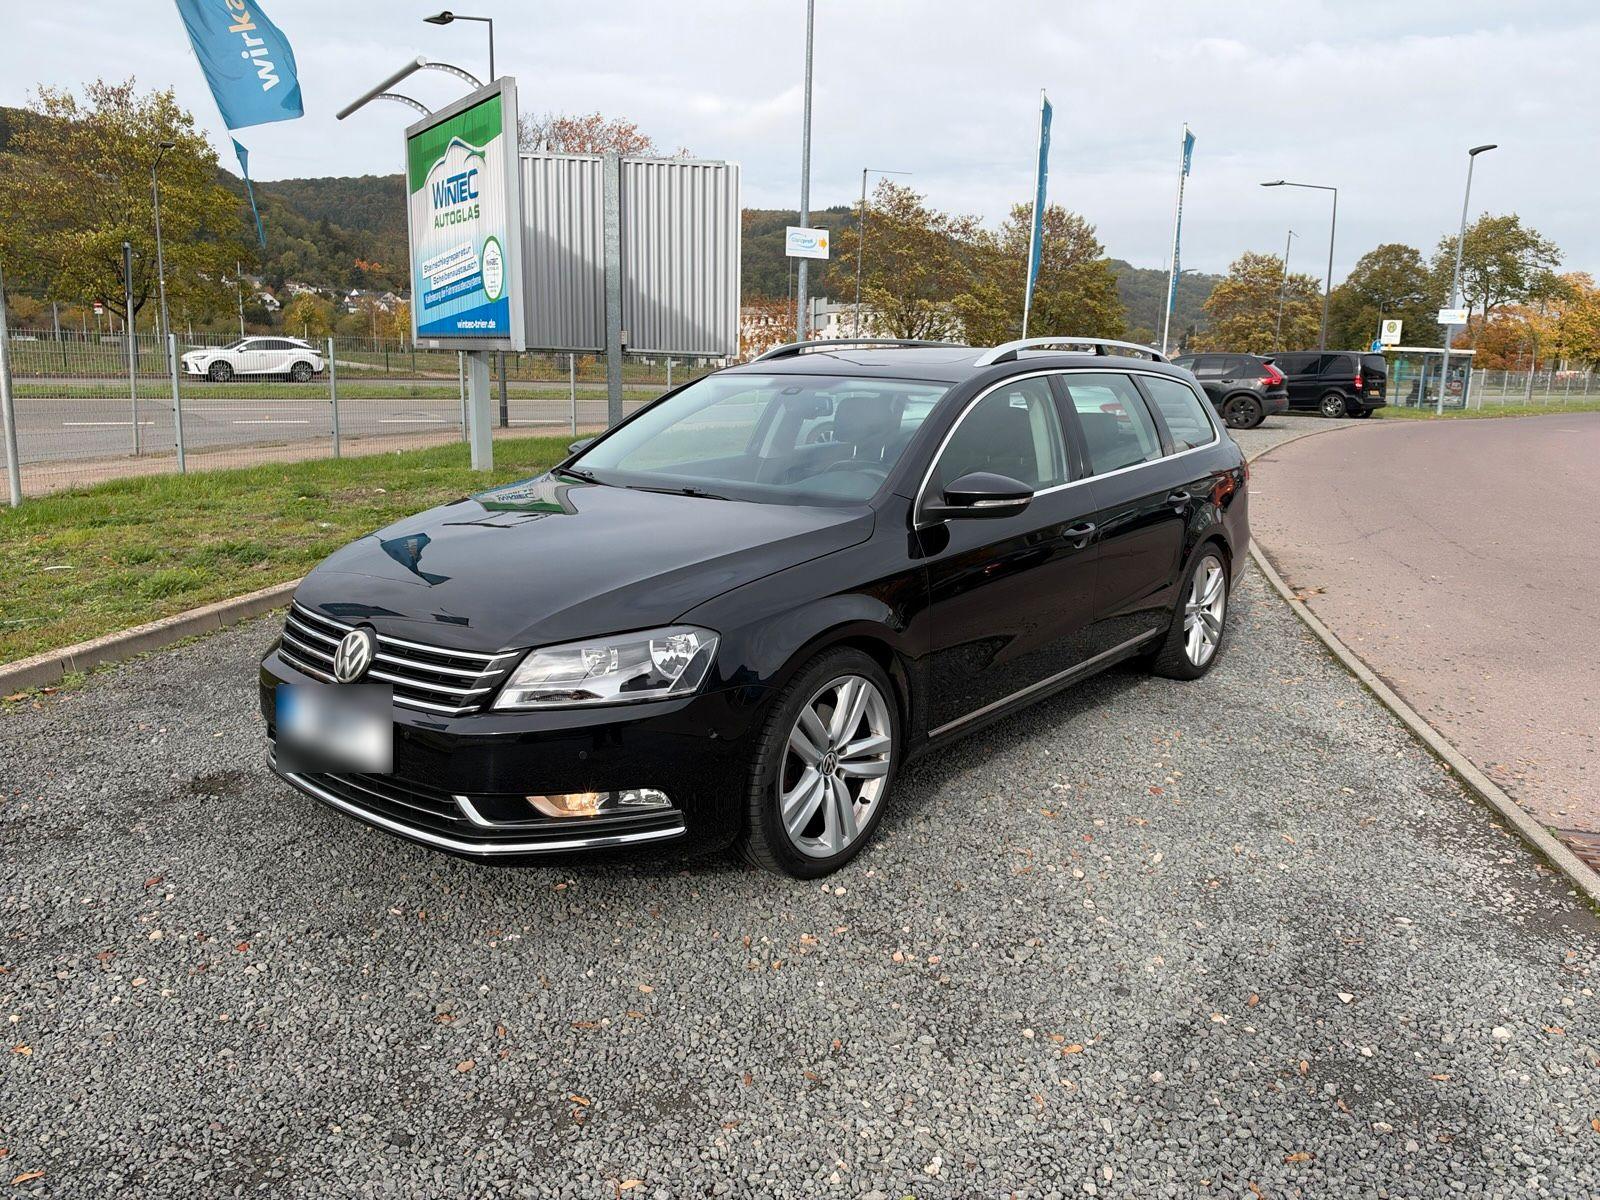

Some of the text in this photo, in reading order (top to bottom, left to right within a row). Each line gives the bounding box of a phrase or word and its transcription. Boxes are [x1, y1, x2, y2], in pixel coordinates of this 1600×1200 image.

[432, 168, 479, 210] WINTEC
[434, 204, 480, 229] AUTOGLAS
[456, 319, 496, 329] wintec-trier.de
[334, 630, 369, 683] VW
